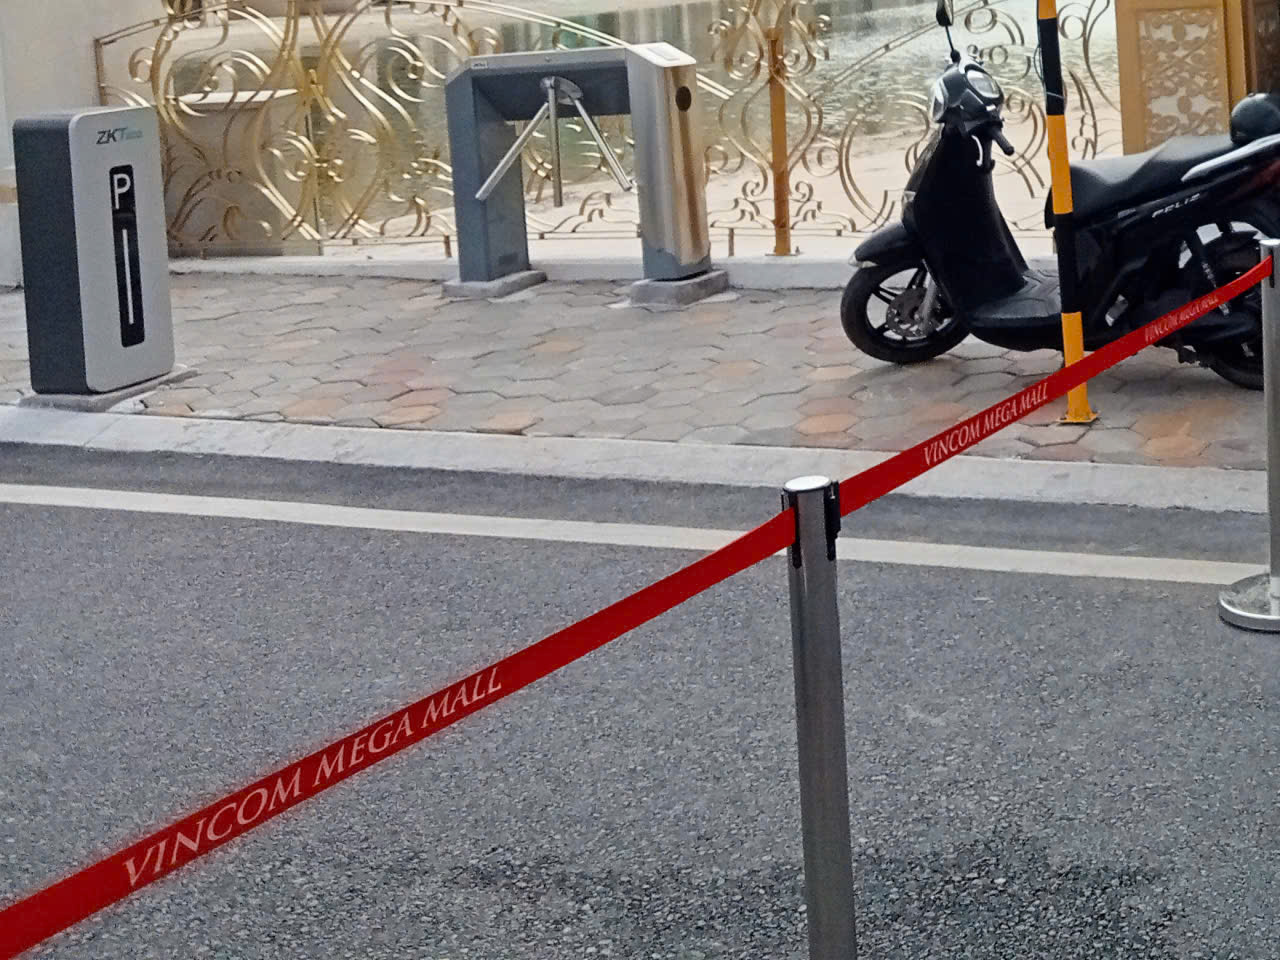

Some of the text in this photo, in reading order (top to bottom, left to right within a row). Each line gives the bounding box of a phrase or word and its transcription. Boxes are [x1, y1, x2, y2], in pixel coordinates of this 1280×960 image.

[96, 126, 142, 144] ZKT
[113, 173, 131, 209] P
[924, 382, 1048, 466] VINCOM MEGA MALL
[124, 667, 502, 887] VINCOM MEGA MALL
